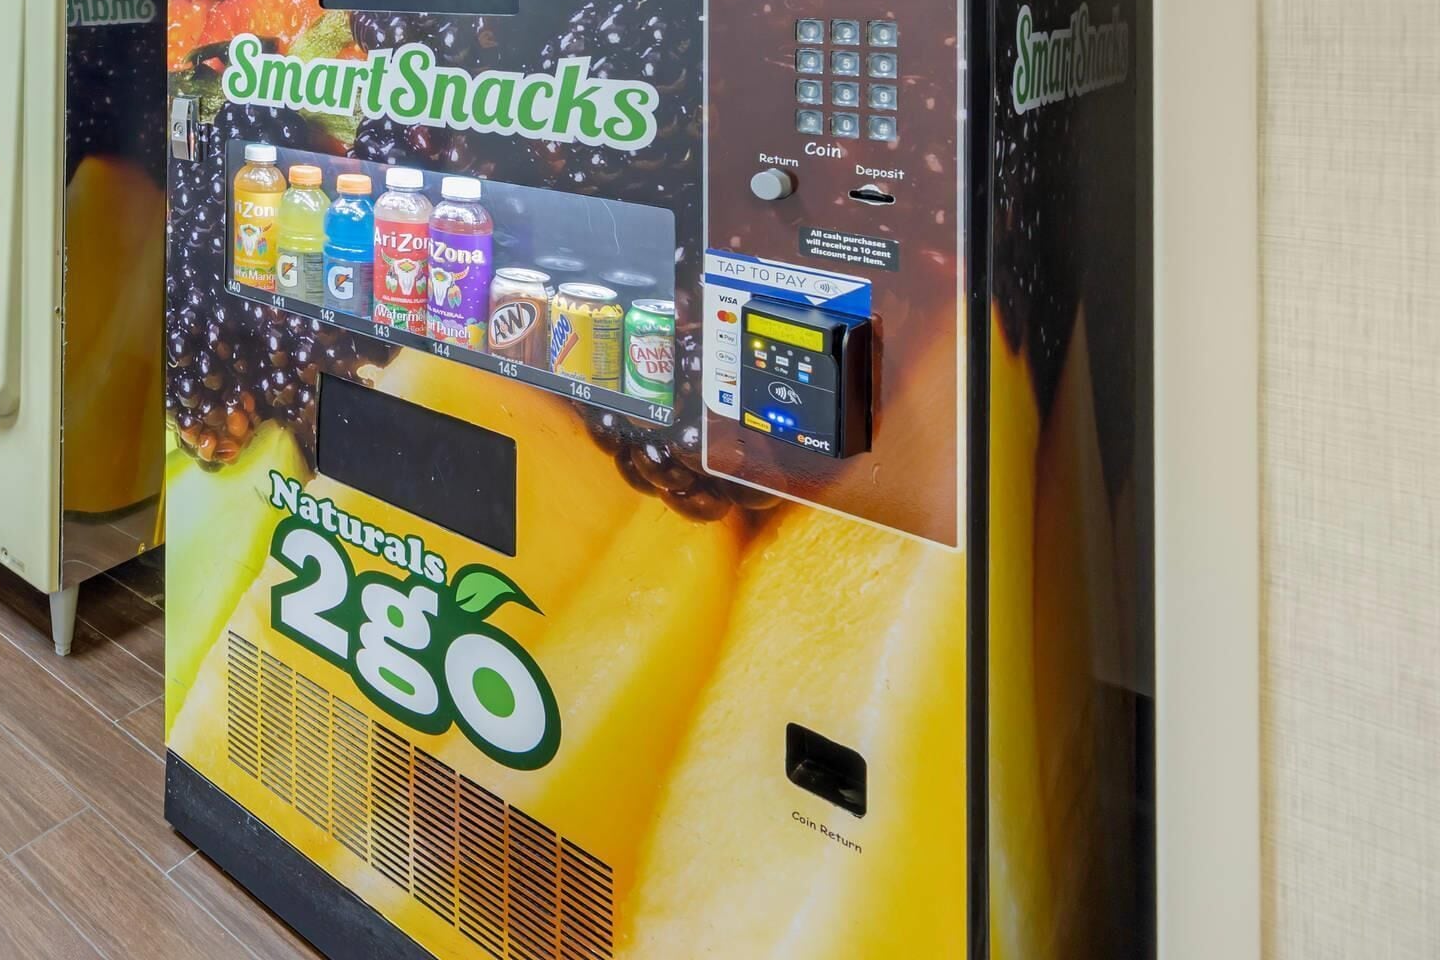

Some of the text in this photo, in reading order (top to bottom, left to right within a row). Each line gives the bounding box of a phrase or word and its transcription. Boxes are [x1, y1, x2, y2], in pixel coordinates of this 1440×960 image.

[224, 35, 656, 147] SmartSnacks
[804, 142, 843, 159] Coin
[759, 153, 799, 167] Return
[855, 164, 905, 181] Deposit
[810, 229, 887, 248] All cash purchases
[805, 238, 821, 246] will
[822, 240, 852, 251] receive
[860, 246, 871, 254] 10
[872, 249, 891, 258] cent
[810, 247, 847, 260] discount
[327, 265, 354, 300] G
[717, 260, 807, 289] TAP TO PAY
[228, 280, 241, 293] 140
[272, 295, 285, 307] 141
[719, 295, 738, 305] VISA
[320, 309, 335, 322] 142
[374, 324, 390, 338] 143
[433, 343, 450, 357] 144
[498, 361, 518, 377] 145
[570, 382, 591, 400] 146
[648, 404, 671, 422] 147
[797, 434, 830, 451] eport
[270, 471, 446, 583] Naturals
[278, 528, 547, 754] 2go
[791, 810, 862, 854] Coin Return
